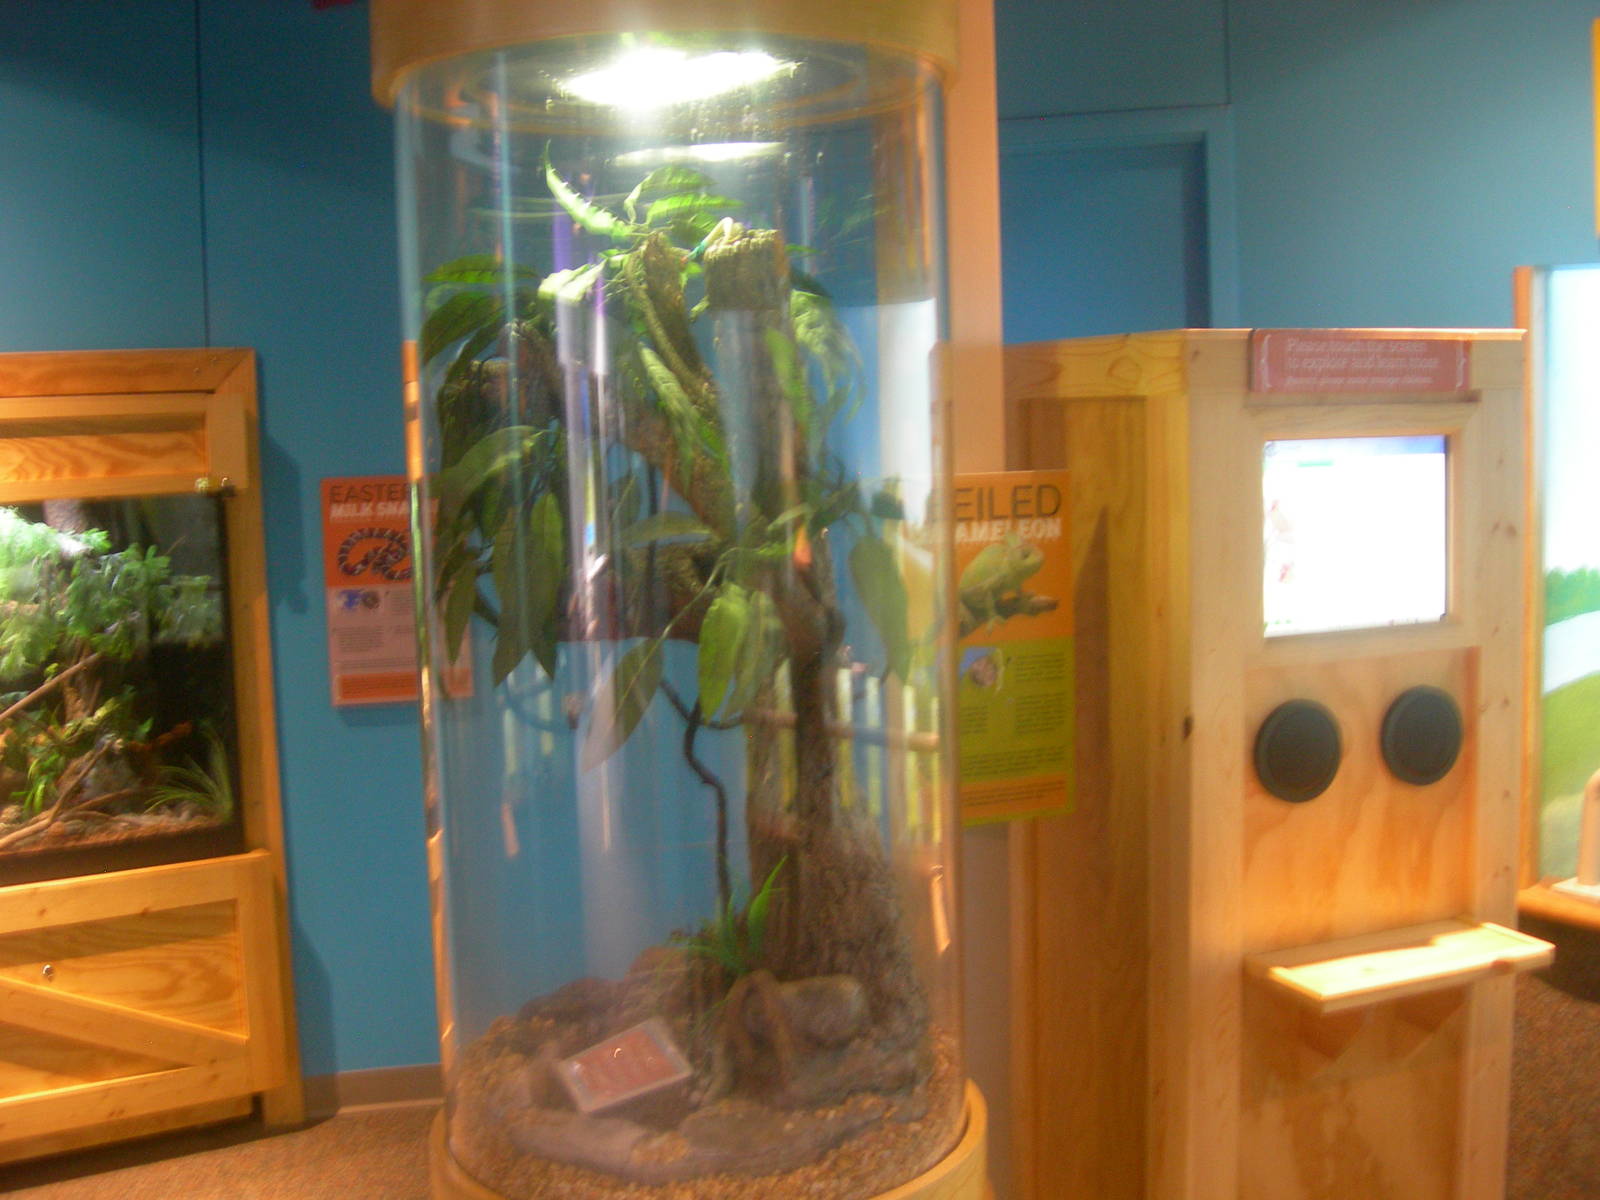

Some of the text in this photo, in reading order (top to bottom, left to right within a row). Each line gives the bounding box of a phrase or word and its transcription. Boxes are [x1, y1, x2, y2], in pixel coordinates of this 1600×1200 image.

[329, 483, 410, 504] EASTE
[954, 483, 1062, 522] EILED
[329, 500, 410, 517] MILK SNA
[954, 518, 1062, 543] AMELEON
